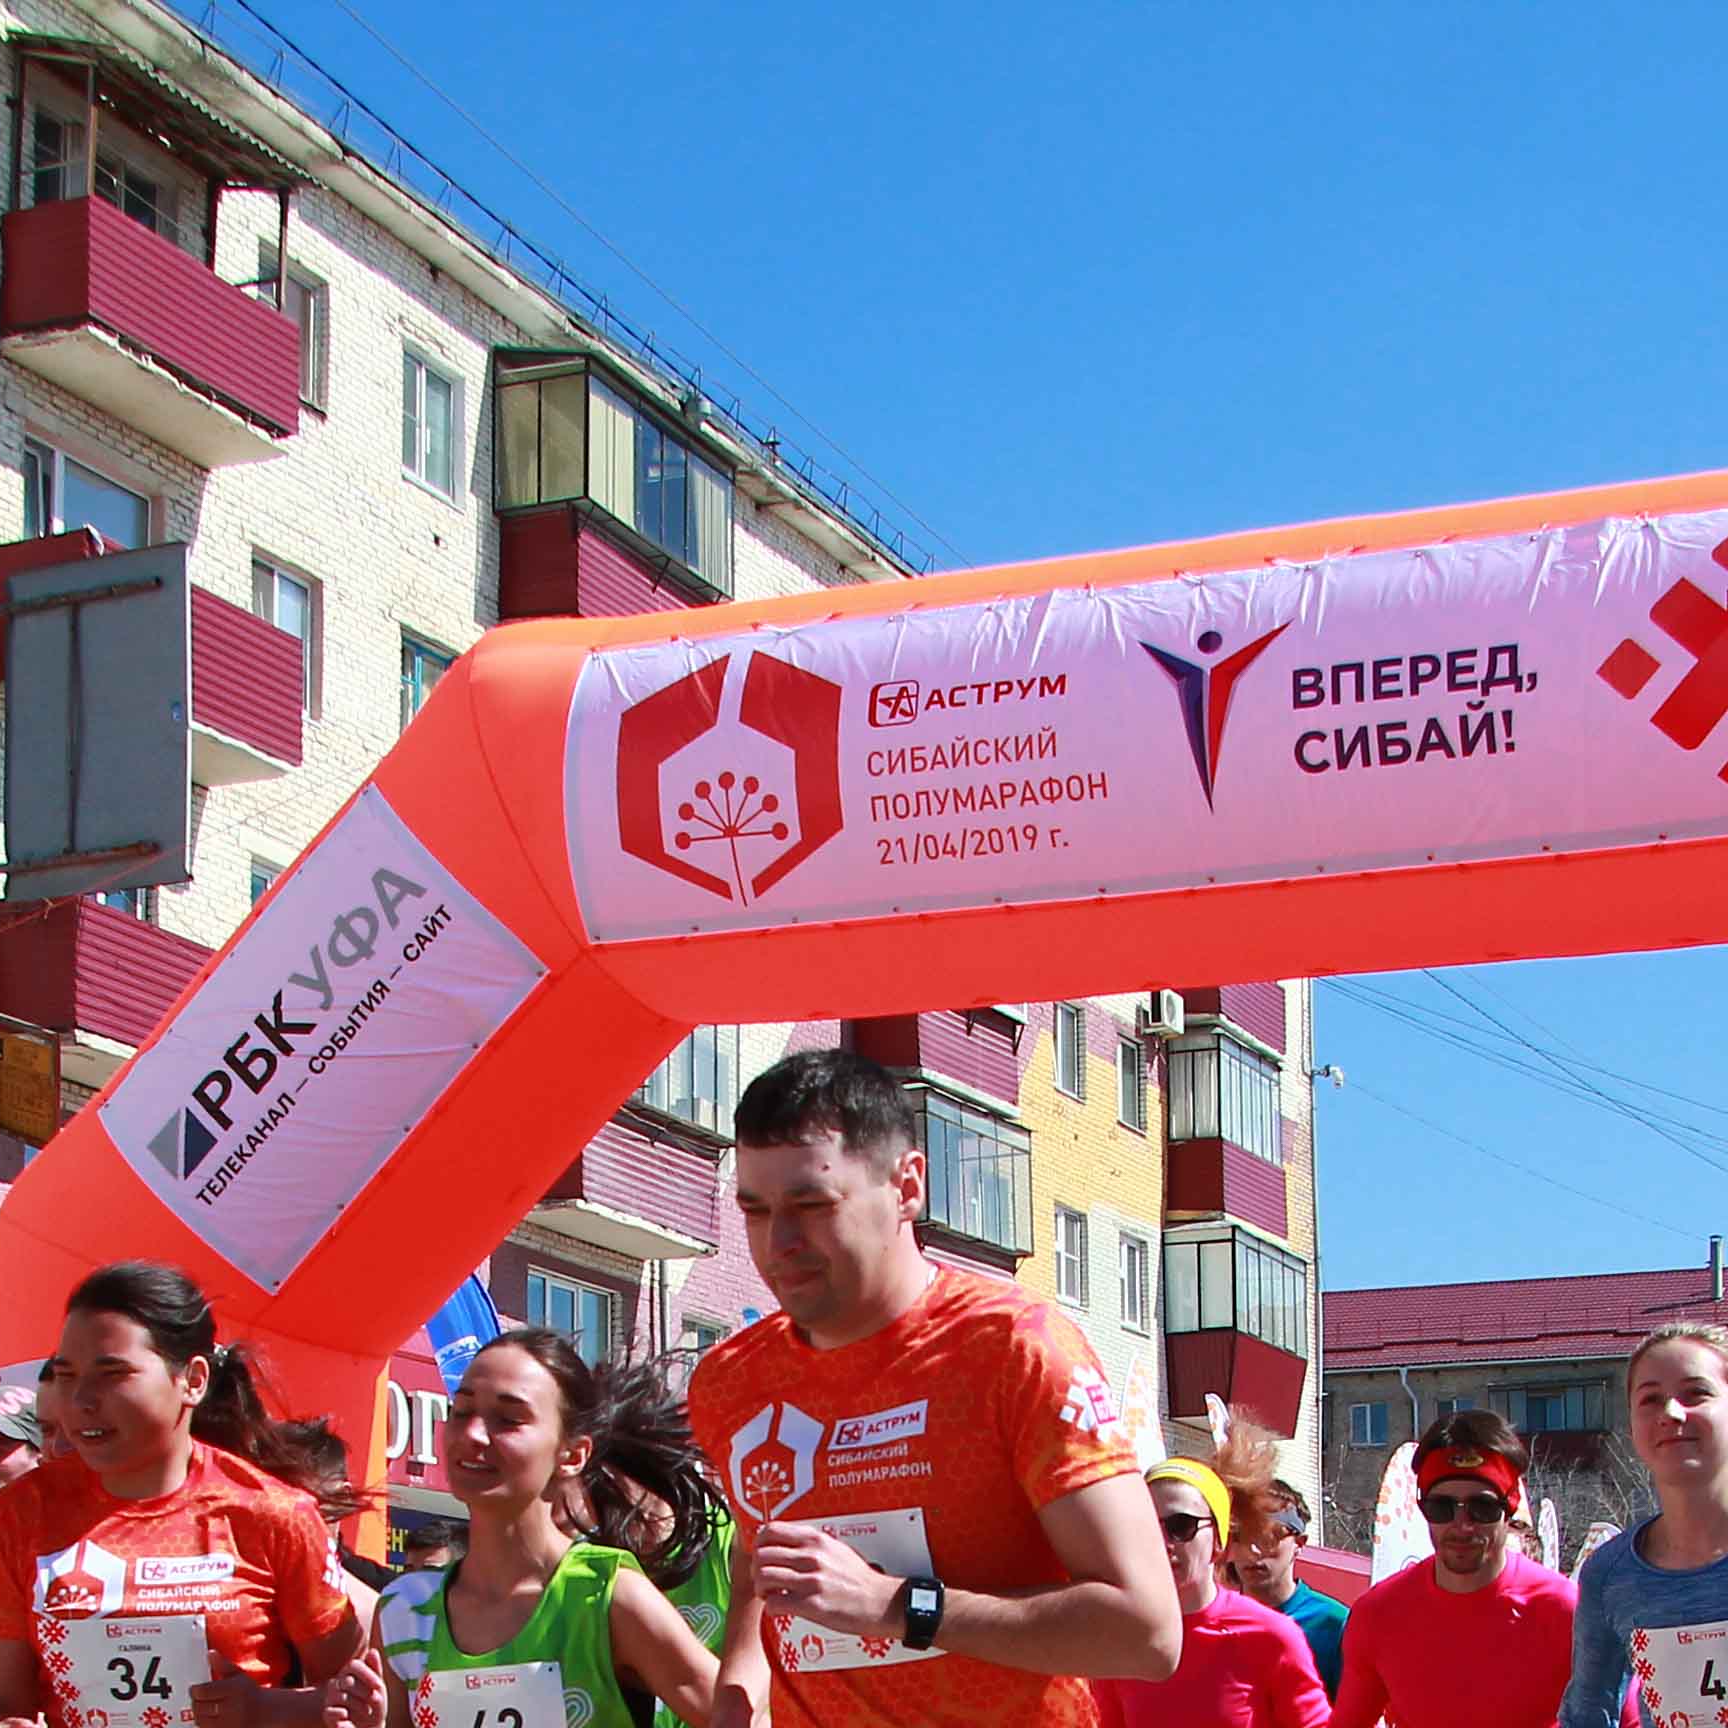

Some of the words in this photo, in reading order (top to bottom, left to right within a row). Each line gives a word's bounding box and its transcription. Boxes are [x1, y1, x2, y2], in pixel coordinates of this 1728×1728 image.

[924, 673, 1068, 712] АСТРУМ
[1291, 642, 1538, 710] ВПЕРЕД,
[866, 726, 1058, 778] СИБАЙСКИЙ
[1293, 699, 1516, 775] СИБАЙ!
[870, 771, 1109, 824] ПОЛУМАРАФОН
[876, 823, 1039, 867] 21/04/2019
[1048, 827, 1070, 849] г.
[191, 988, 318, 1132] РБК
[288, 866, 428, 1011] УФА
[195, 1091, 297, 1207] ТЕЛЕКАНАЛ
[307, 977, 391, 1077] СОБЫТИЯ
[402, 903, 454, 964] САЙТ
[865, 1410, 921, 1435] АСТРУМ
[828, 1461, 933, 1488] ПОЛУМАРАФОН
[169, 1560, 229, 1575] АСТРУМ
[106, 1656, 173, 1701] 34
[1700, 1660, 1727, 1701] 4
